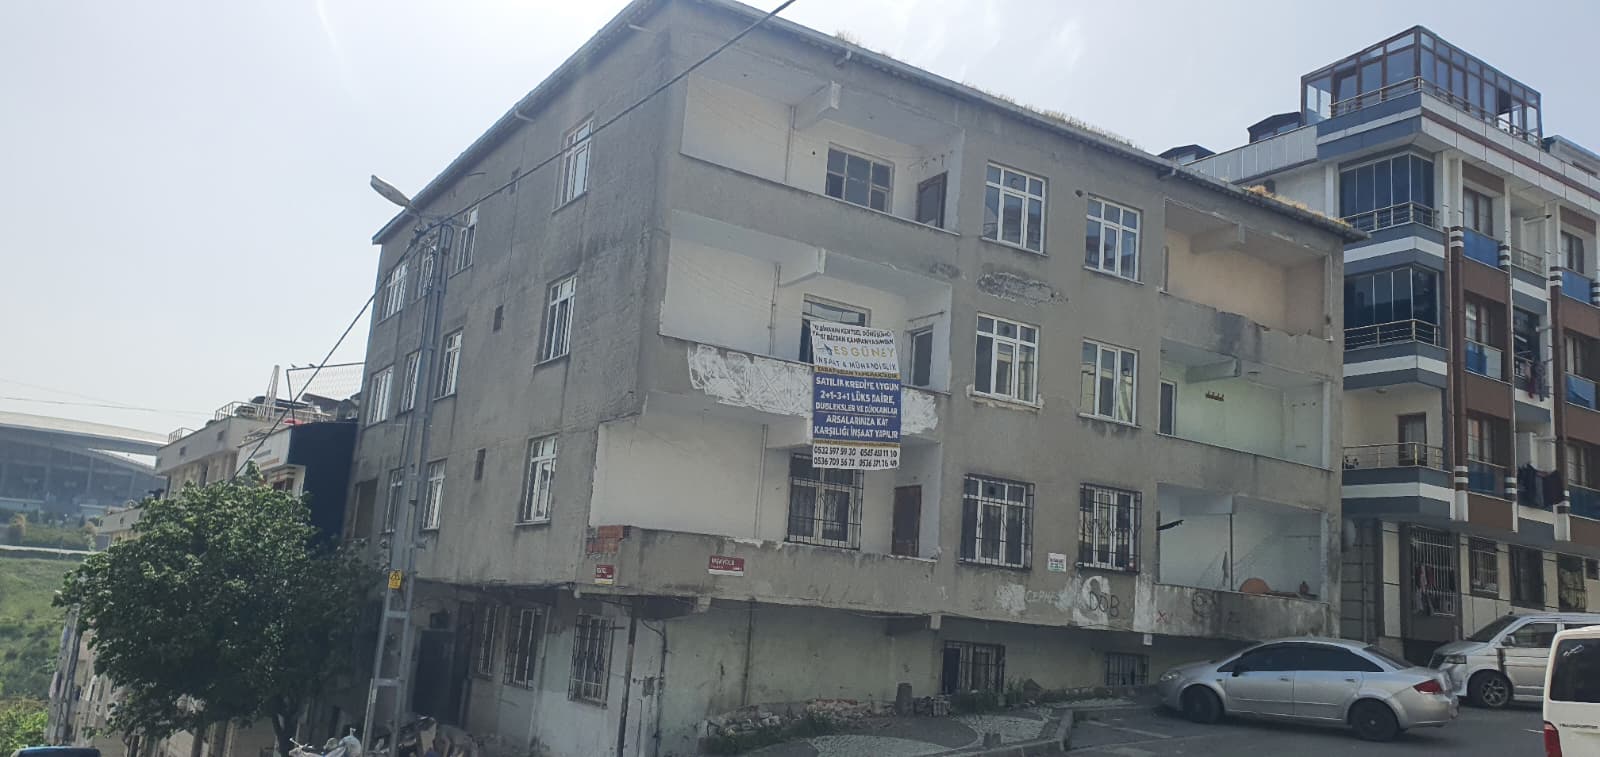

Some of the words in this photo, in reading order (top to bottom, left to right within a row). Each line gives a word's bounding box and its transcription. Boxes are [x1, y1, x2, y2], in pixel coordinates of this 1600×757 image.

[816, 377, 844, 387] SATILIK
[845, 379, 875, 390] KREDİYE
[875, 383, 899, 391] UYGUN
[820, 391, 850, 401] 2+1-3+1
[851, 392, 871, 402] LÜKS
[826, 414, 875, 426] ARSALARINIZA
[876, 418, 889, 427] KAT
[814, 425, 849, 438] KARŞILIĞI
[850, 426, 874, 438] İNŞAAT
[874, 430, 899, 439] YAPILIR
